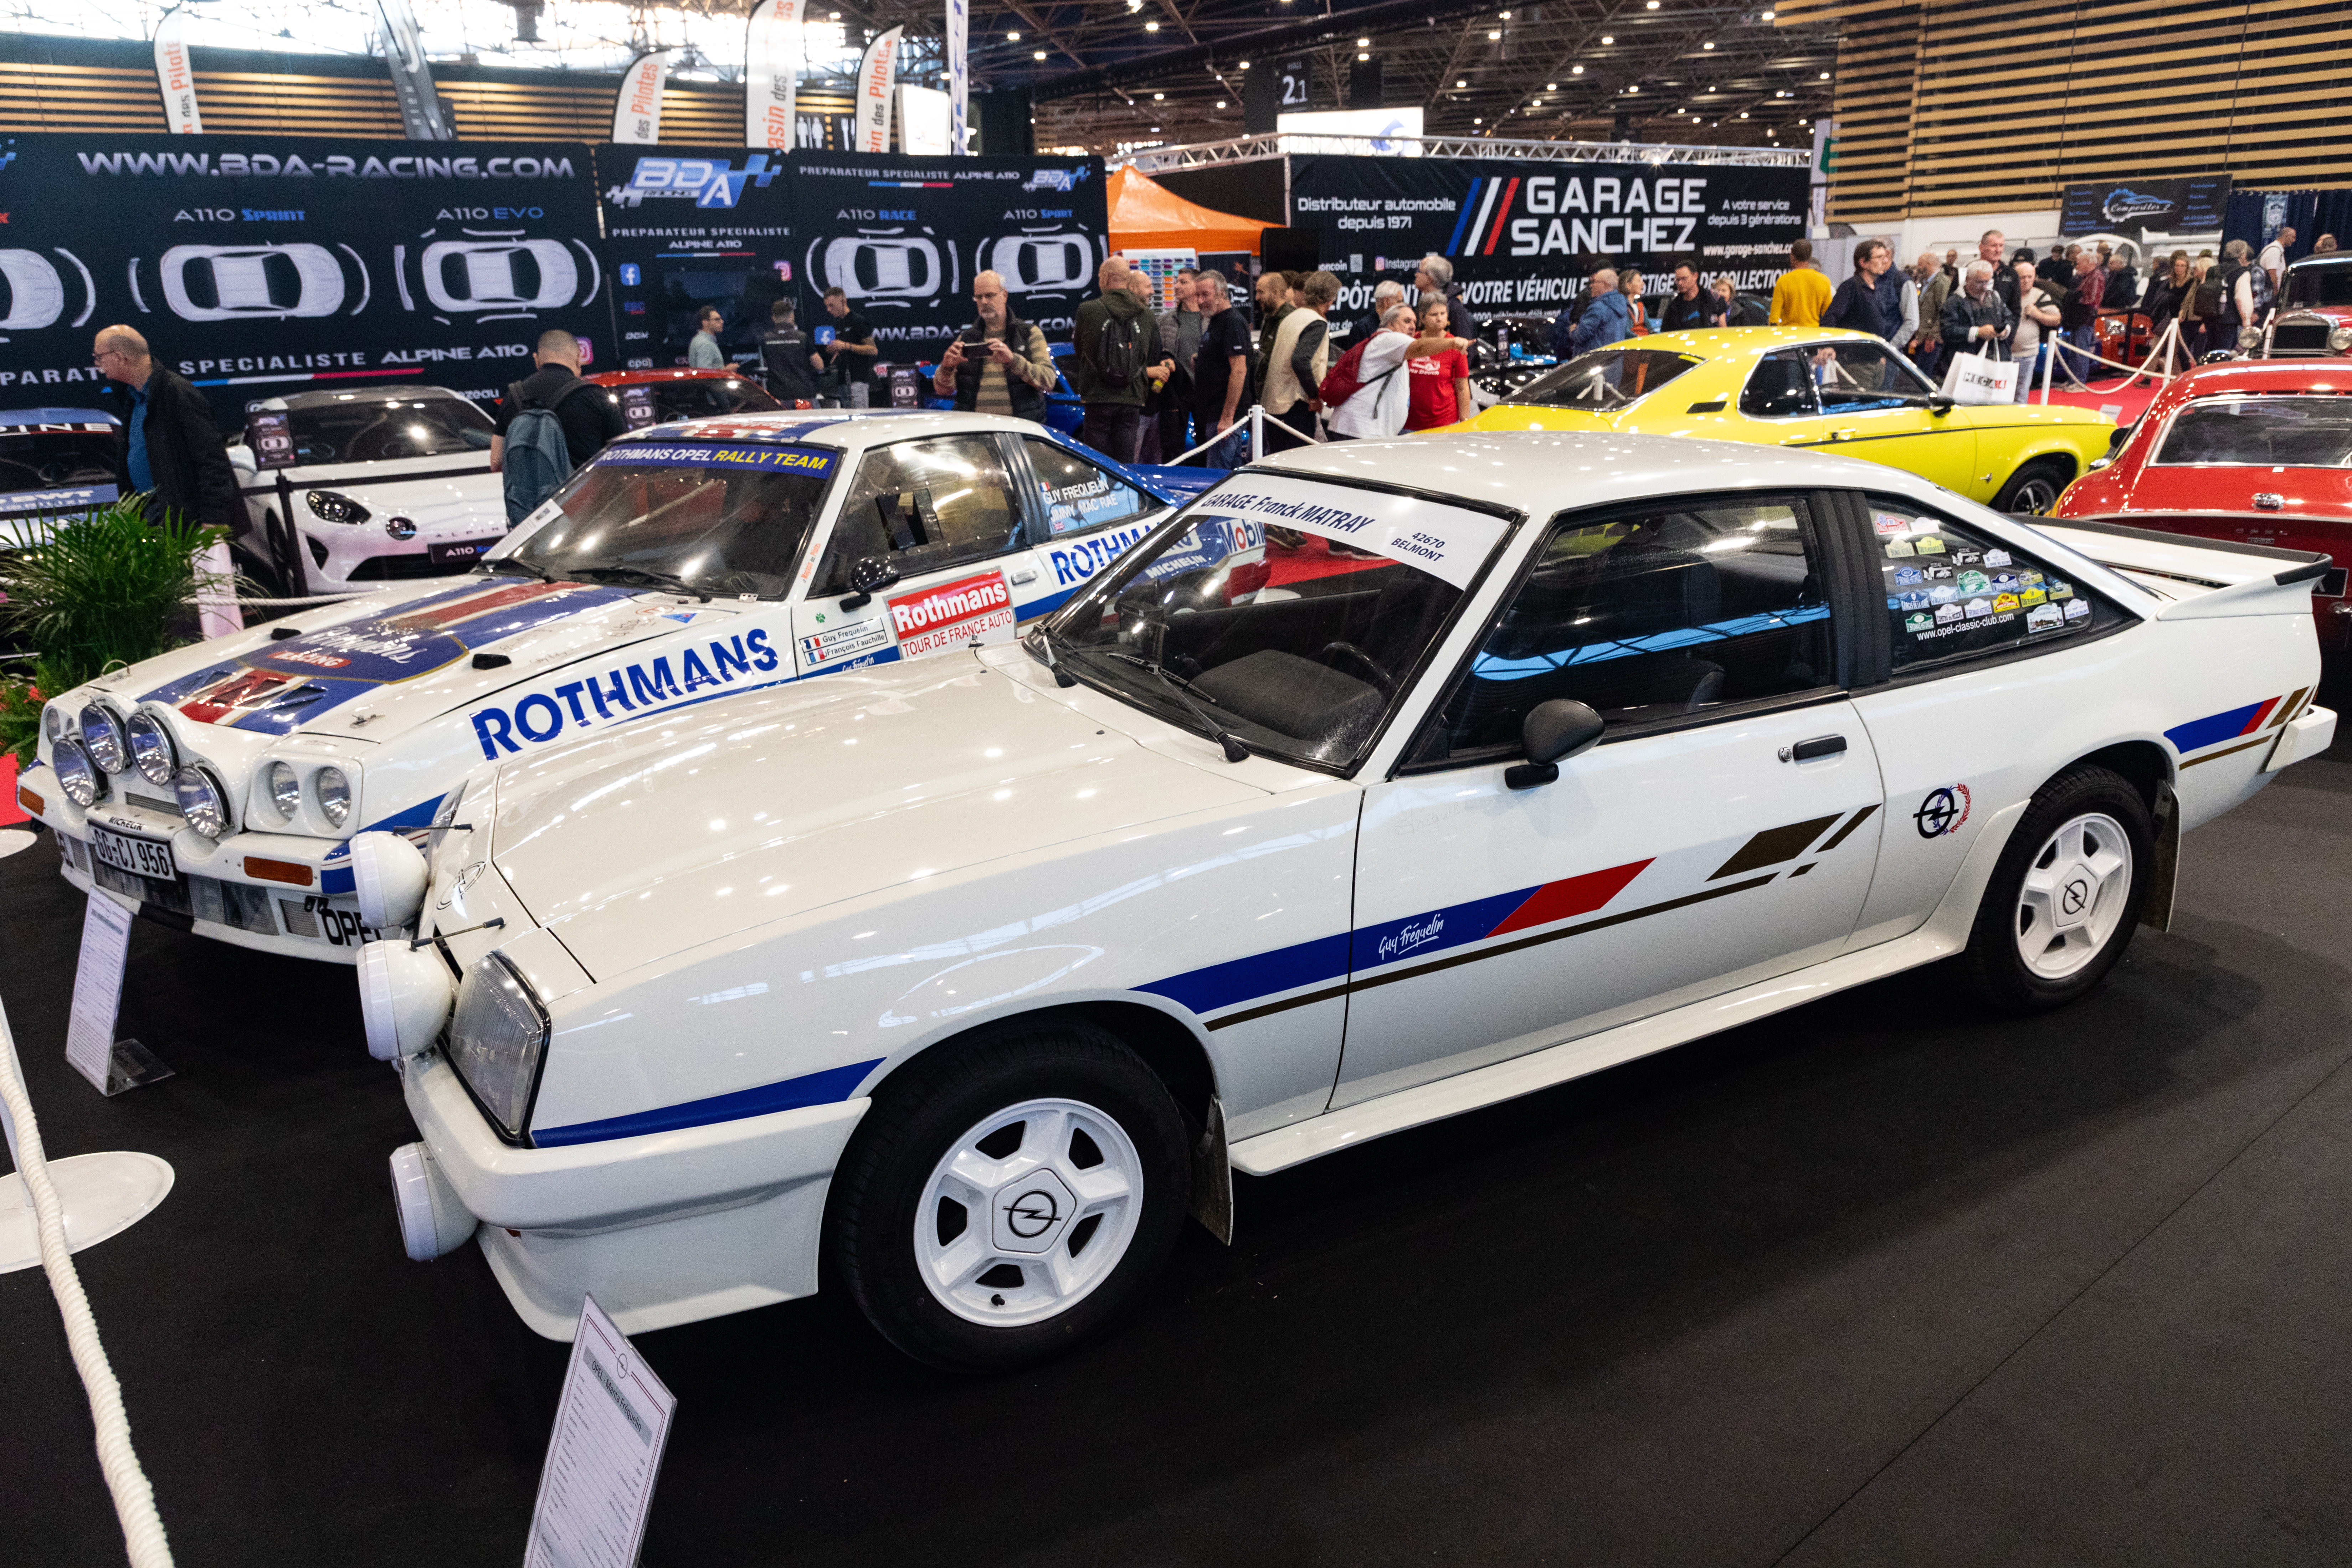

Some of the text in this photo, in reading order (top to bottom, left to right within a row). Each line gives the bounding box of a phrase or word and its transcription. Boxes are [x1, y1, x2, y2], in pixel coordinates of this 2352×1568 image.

[771, 74, 788, 101] des
[1283, 75, 1308, 104] 2.1
[631, 63, 659, 139] des Pilotes
[872, 104, 884, 125] des
[77, 153, 575, 178] WWW.BDA-RACING.COM
[800, 166, 878, 178] PREPARATEUR
[883, 169, 949, 179] SPECIALISTE
[634, 160, 732, 206] BDA
[1298, 198, 1455, 211] Distributeur automobile
[1527, 177, 1707, 214] GARAGE
[1732, 201, 1756, 210] votre
[1757, 199, 1790, 210] service
[174, 209, 235, 222] A110
[436, 207, 544, 220] A110 EVO
[836, 210, 875, 220] A110
[1003, 209, 1037, 220] A110
[1338, 216, 1412, 232] depuis 1971
[1708, 213, 1739, 228] depuis
[612, 227, 790, 237] PREPARATEUR SPECIALISTE
[1511, 218, 1696, 256] SANCHEZ
[669, 240, 742, 249] ALPINE A110
[1703, 241, 1793, 258] www.garage-sanchez.co
[1319, 259, 1347, 271] oncoin
[1462, 280, 1514, 304] VOTRE
[179, 351, 365, 375] SPECIALISTE
[381, 347, 473, 363] ALPINE
[477, 344, 528, 359] A110
[601, 449, 828, 470] ROTHMANS OPEL RALLY TEAM
[1042, 478, 1109, 504] GUY FREQUELIN
[1051, 494, 1119, 522] JIMMY MAC RAE
[1202, 493, 1377, 533] GARAGE Franck MATRAY
[1391, 538, 1445, 562] BELMONT
[1412, 531, 1445, 549] 42670
[1145, 554, 1206, 579] MICHELIN
[892, 583, 1007, 633] Rothmans
[838, 626, 868, 639] Frequelin
[902, 611, 1012, 657] TOUR DE FRANCE AUTO
[1917, 613, 2014, 641] www.opel-classic-club.com
[857, 634, 885, 647] Fauchille
[275, 652, 344, 667] RACING
[469, 628, 779, 761] ROTHMANS
[108, 816, 143, 831] MICHELIN
[137, 842, 170, 876] 956
[1379, 914, 1444, 960] Guy Fréquelin
[591, 1359, 604, 1381] OPEL
[605, 1378, 621, 1404] Manta
[619, 1396, 642, 1434] Fréquelin
